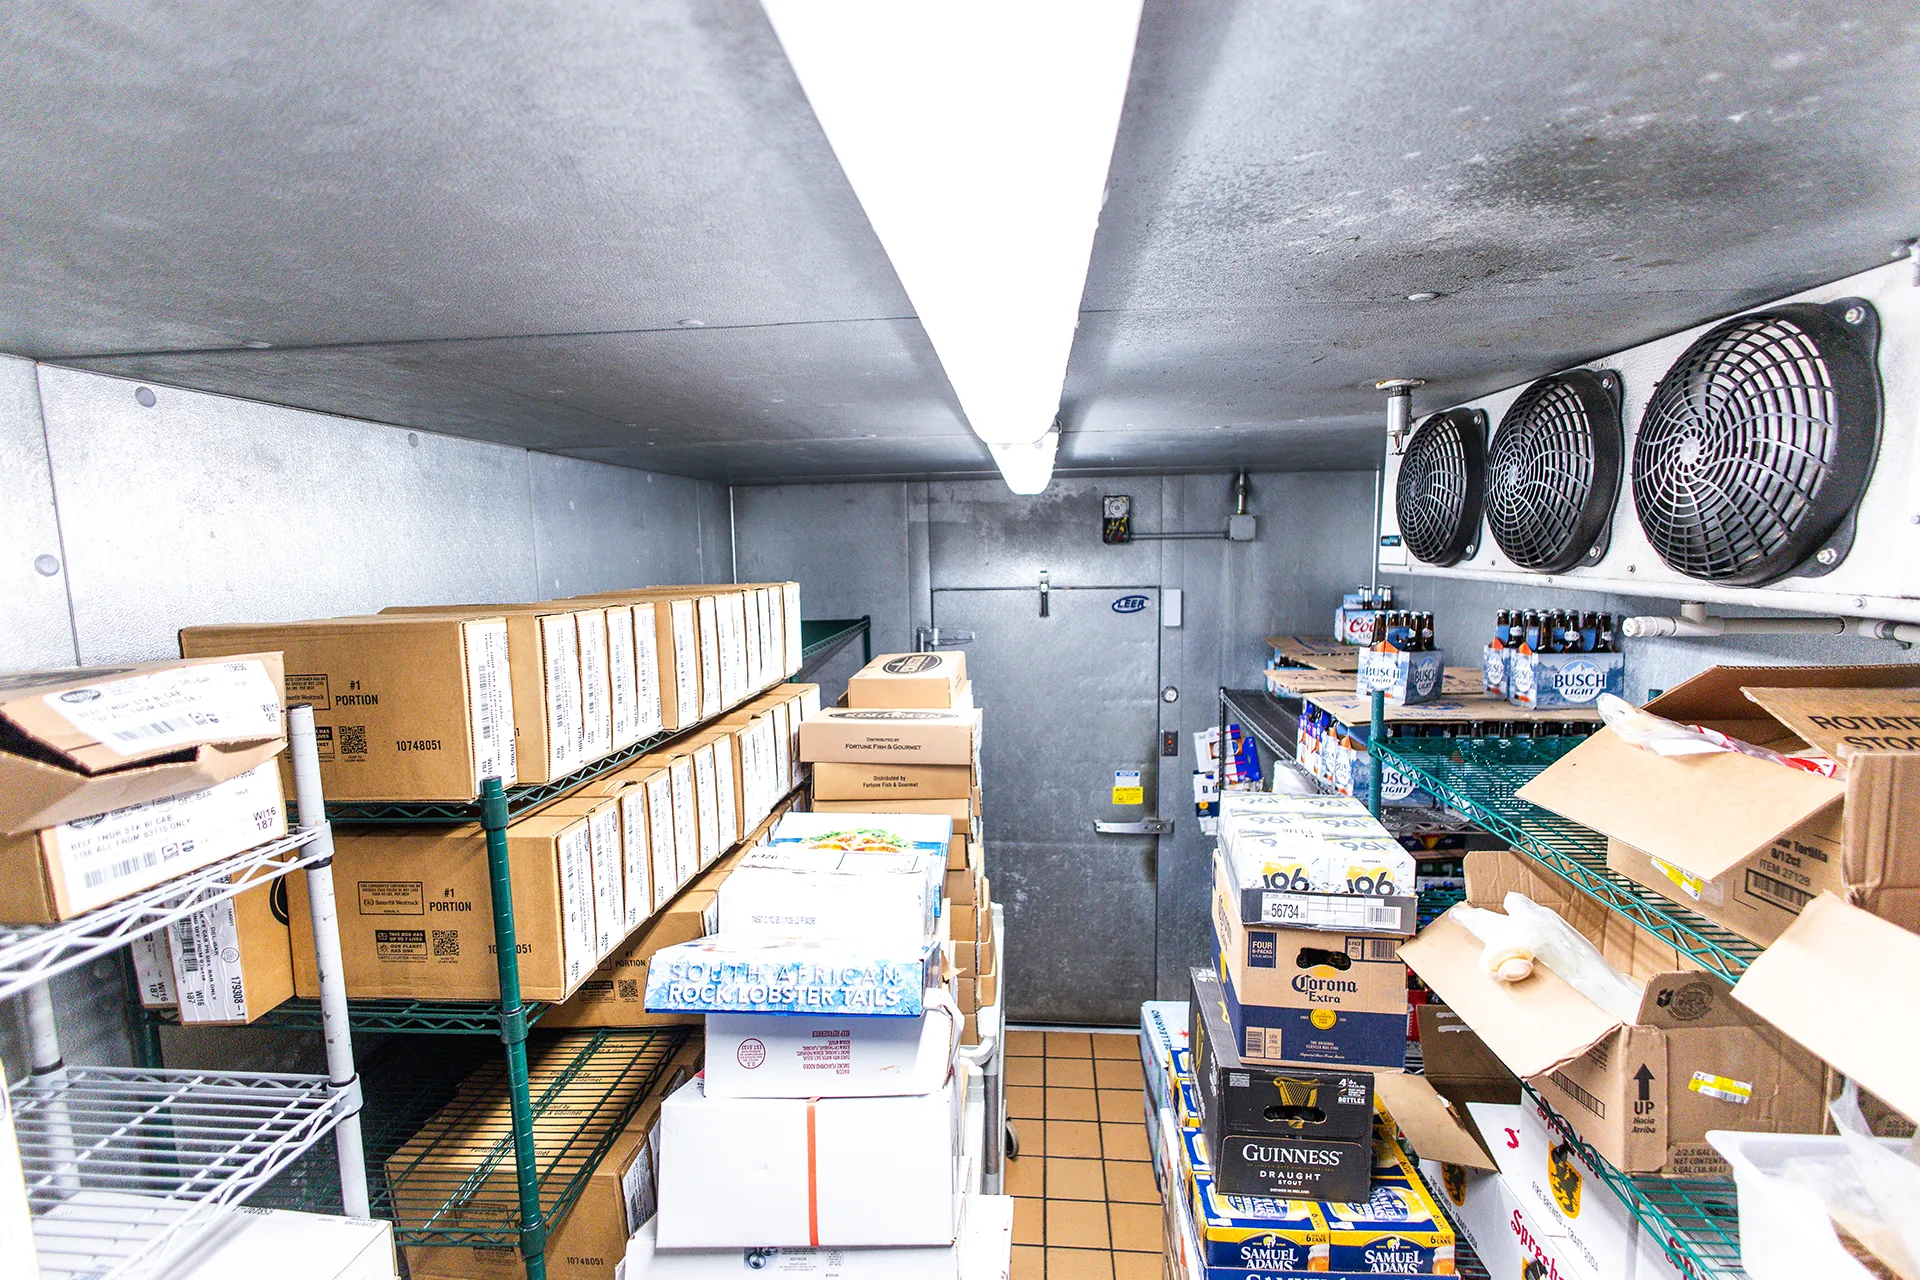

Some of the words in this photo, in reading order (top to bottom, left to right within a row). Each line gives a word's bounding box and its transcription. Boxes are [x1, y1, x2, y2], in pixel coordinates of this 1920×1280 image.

[1117, 598, 1145, 609] LEER
[1365, 667, 1401, 679] BUSCH
[1414, 668, 1437, 682] BUSCH
[350, 680, 361, 690] #1
[1554, 672, 1607, 689] BUSCH
[1563, 687, 1596, 695] LIGHT
[335, 694, 379, 706] PORTION
[396, 740, 442, 751] 10748051
[1382, 786, 1408, 794] IGHT
[253, 806, 277, 821] WI16
[256, 817, 273, 831] 187
[1794, 840, 1828, 862] Tortilla
[1760, 858, 1780, 874] ITEM
[444, 888, 455, 897] #1
[429, 902, 472, 912] PORTION
[1271, 903, 1300, 919] 56734
[488, 944, 532, 954] 10051
[1252, 941, 1273, 949] FOUR
[671, 964, 762, 984] SOUTH
[776, 964, 901, 985] AFRICAN
[1291, 974, 1359, 994] Corona
[149, 983, 160, 999] 187
[158, 981, 168, 1002] WI16
[668, 984, 734, 1004] ROCK
[739, 985, 832, 1004] LOBSTER
[842, 987, 900, 1006] TAILS
[1309, 991, 1341, 1004] Extra
[195, 989, 205, 1007] WI16
[1338, 1096, 1366, 1105] BOTTLES
[1633, 1101, 1655, 1115] UP
[1633, 1117, 1655, 1125] Hacia
[1631, 1126, 1656, 1134] Arriba
[1243, 1144, 1340, 1166] GUINNESS
[1260, 1170, 1321, 1181] DRAUGHT
[1240, 1247, 1299, 1261] SAMUEL
[1568, 1227, 1583, 1248] CRAFT
[1584, 1250, 1599, 1272] SODA
[566, 1256, 604, 1265] 10748051
[1365, 1249, 1424, 1264] SAMUEL
[1246, 1260, 1293, 1270] ADAMS
[1370, 1263, 1418, 1273] ADAMS
